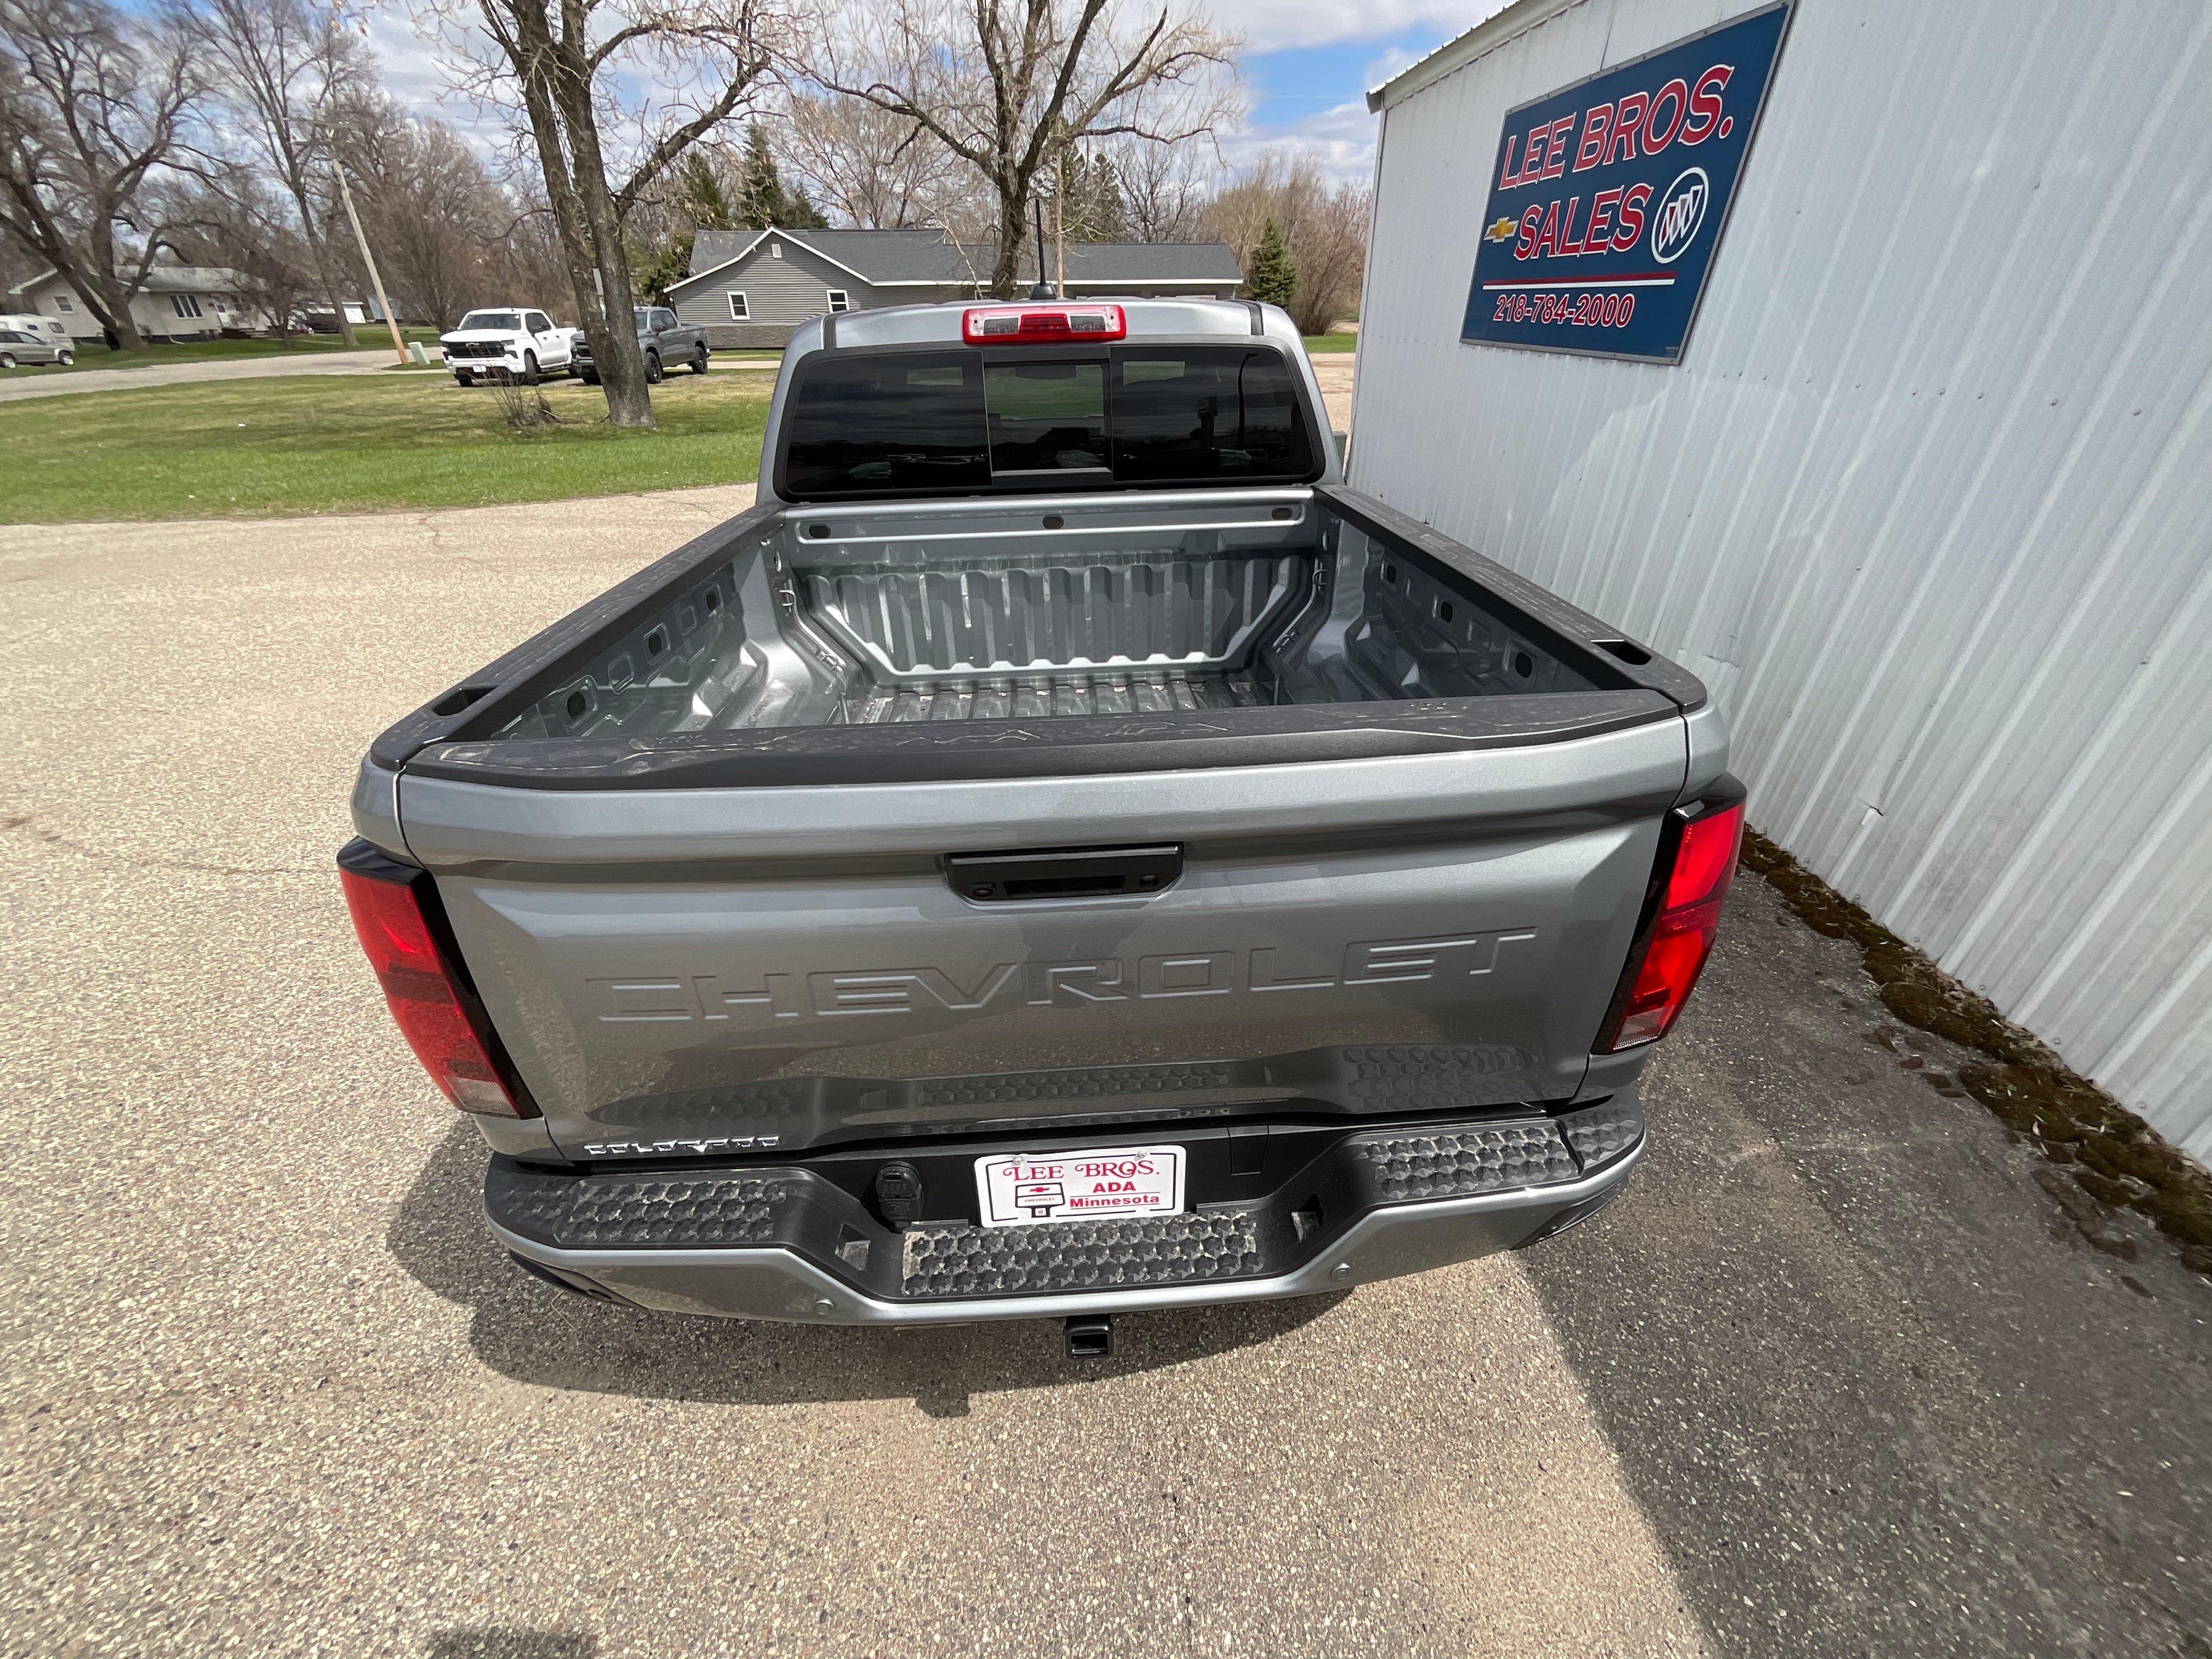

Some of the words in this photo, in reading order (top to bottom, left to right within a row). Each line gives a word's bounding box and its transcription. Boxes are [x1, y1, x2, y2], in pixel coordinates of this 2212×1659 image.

[1498, 111, 1577, 191] LEE
[1572, 65, 1734, 173] BROS.
[1513, 183, 1655, 261] SALES
[1493, 293, 1635, 328] 218-784-2000
[585, 926, 1538, 1020] CHEVROLET
[1003, 1166, 1064, 1181] LEE
[1075, 1160, 1160, 1178] BROS.
[1092, 1181, 1136, 1193] ADA
[1070, 1195, 1159, 1207] Minnesota
